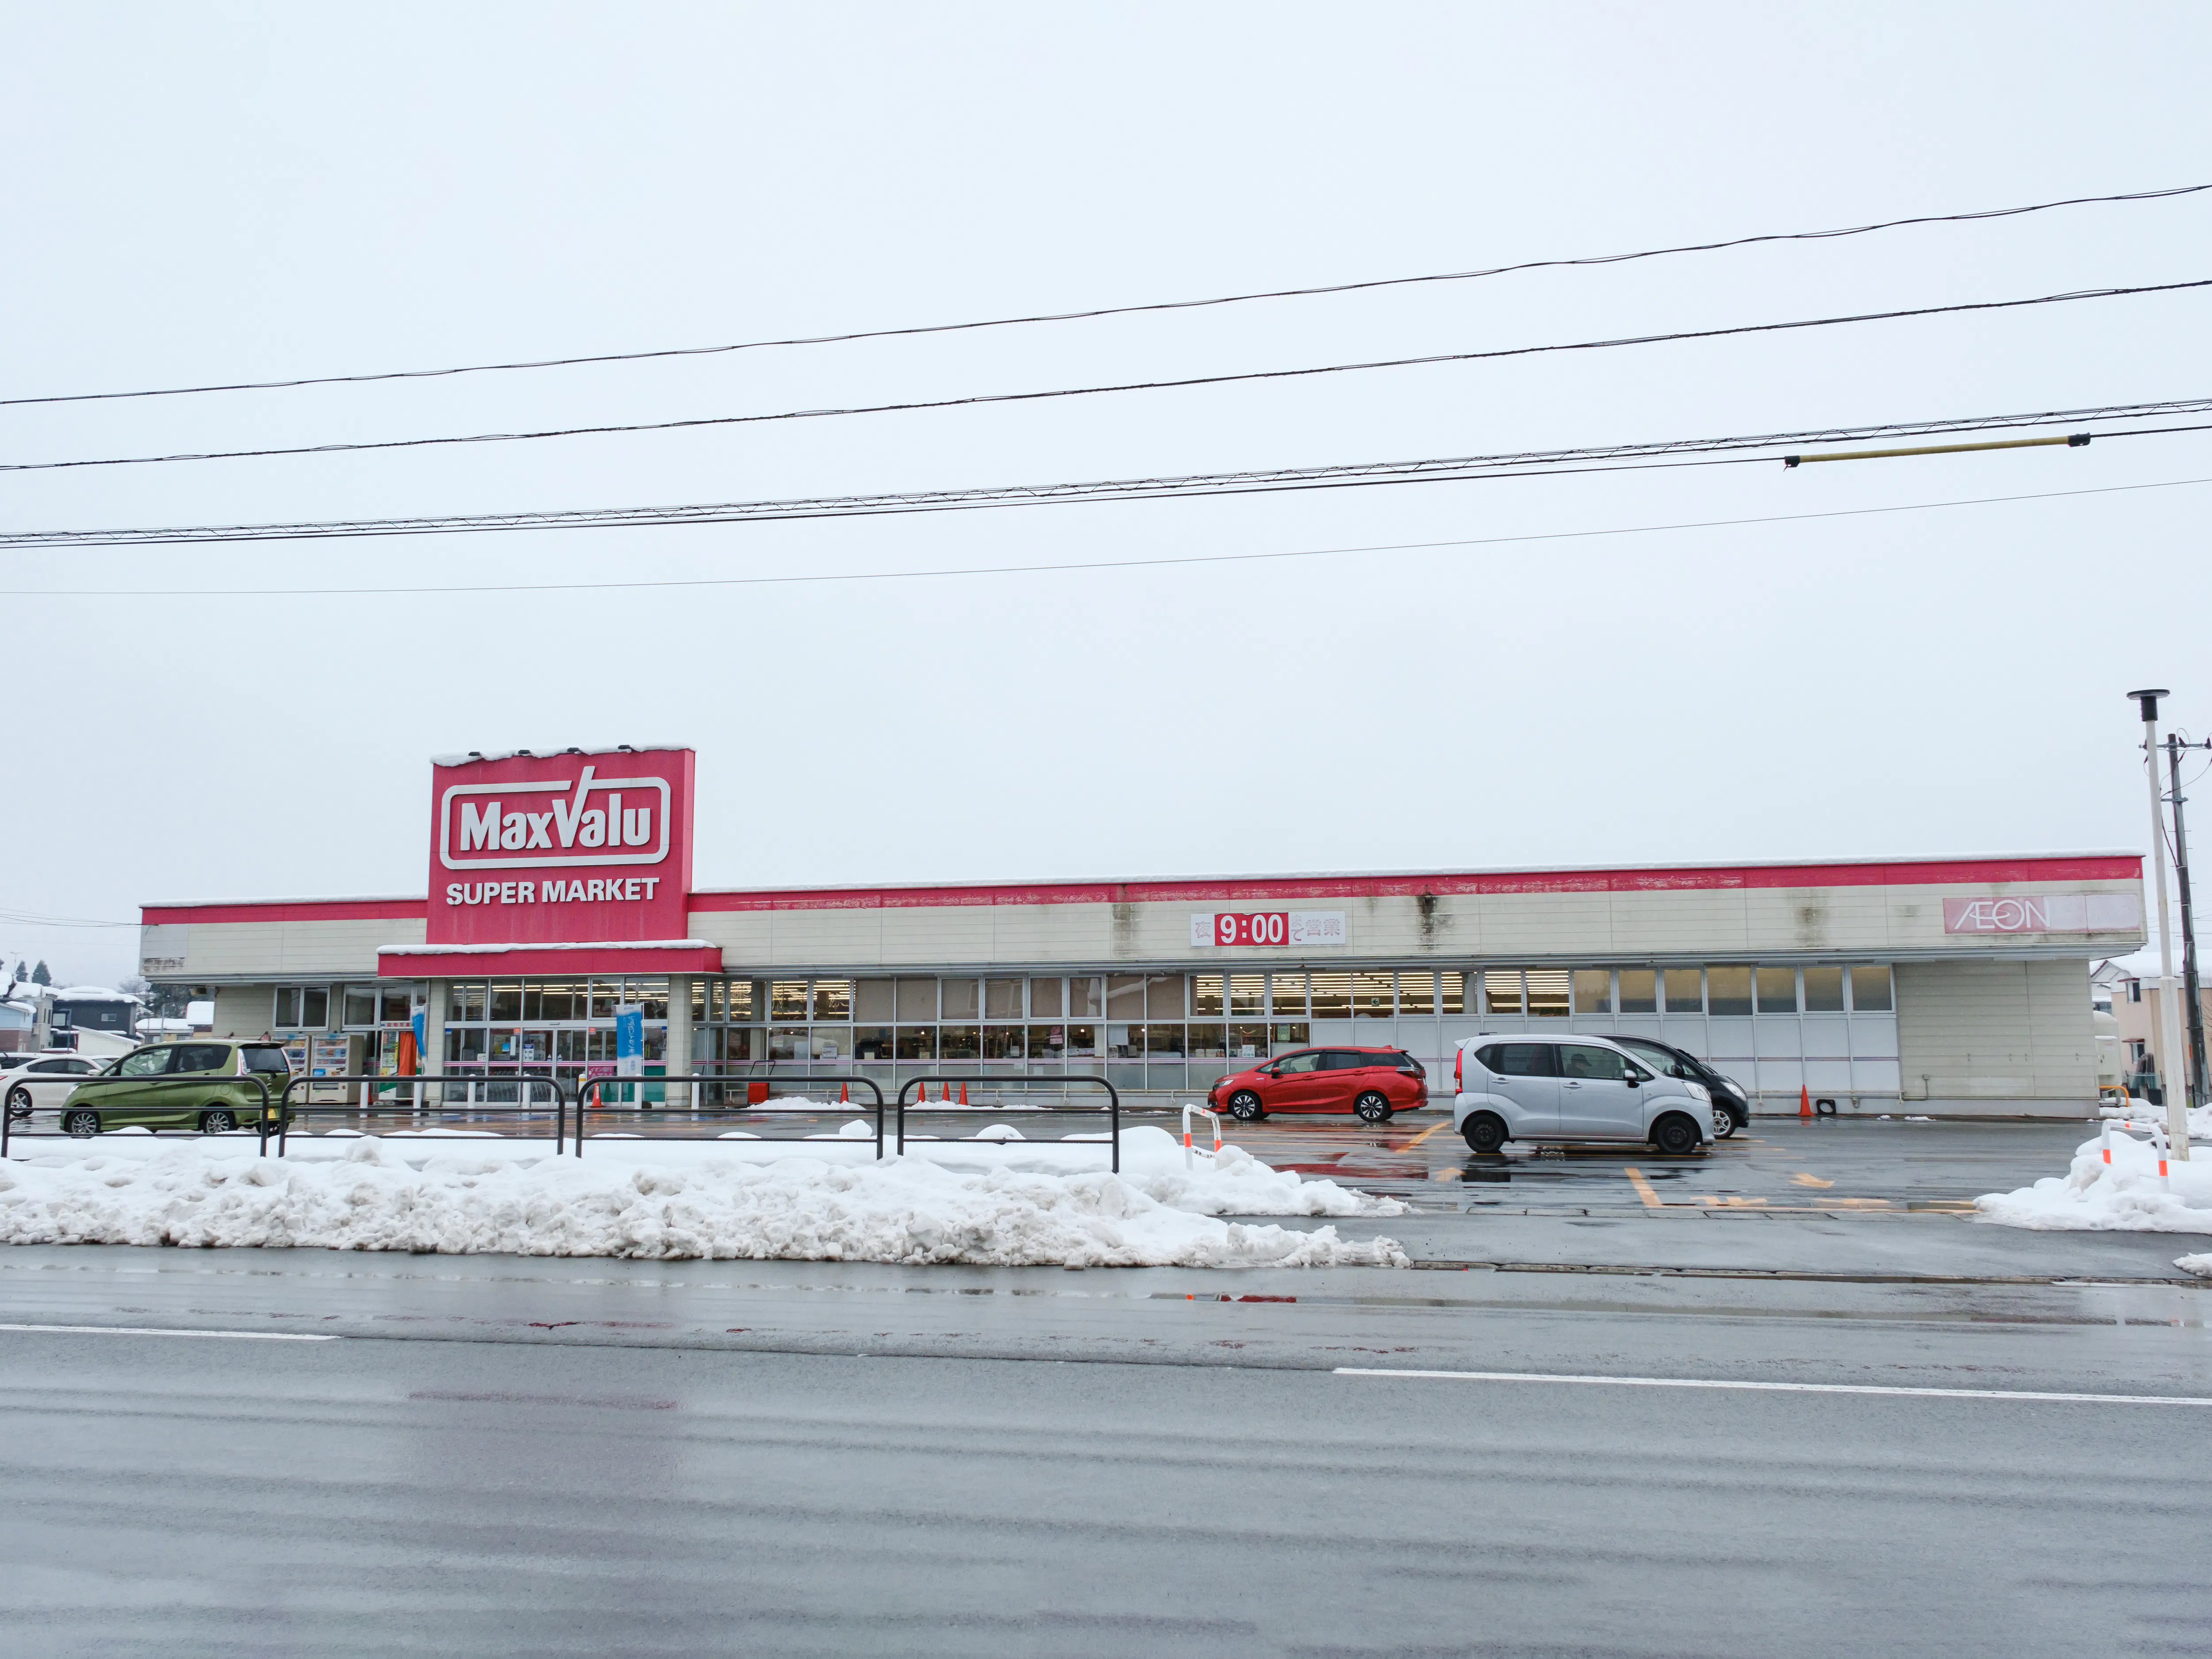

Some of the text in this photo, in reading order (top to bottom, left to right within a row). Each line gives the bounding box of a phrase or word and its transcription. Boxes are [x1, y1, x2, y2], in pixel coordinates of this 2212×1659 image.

[460, 766, 650, 851] MaxValu
[446, 877, 660, 905] SUPER MARKET
[1220, 914, 1283, 944] 9:00
